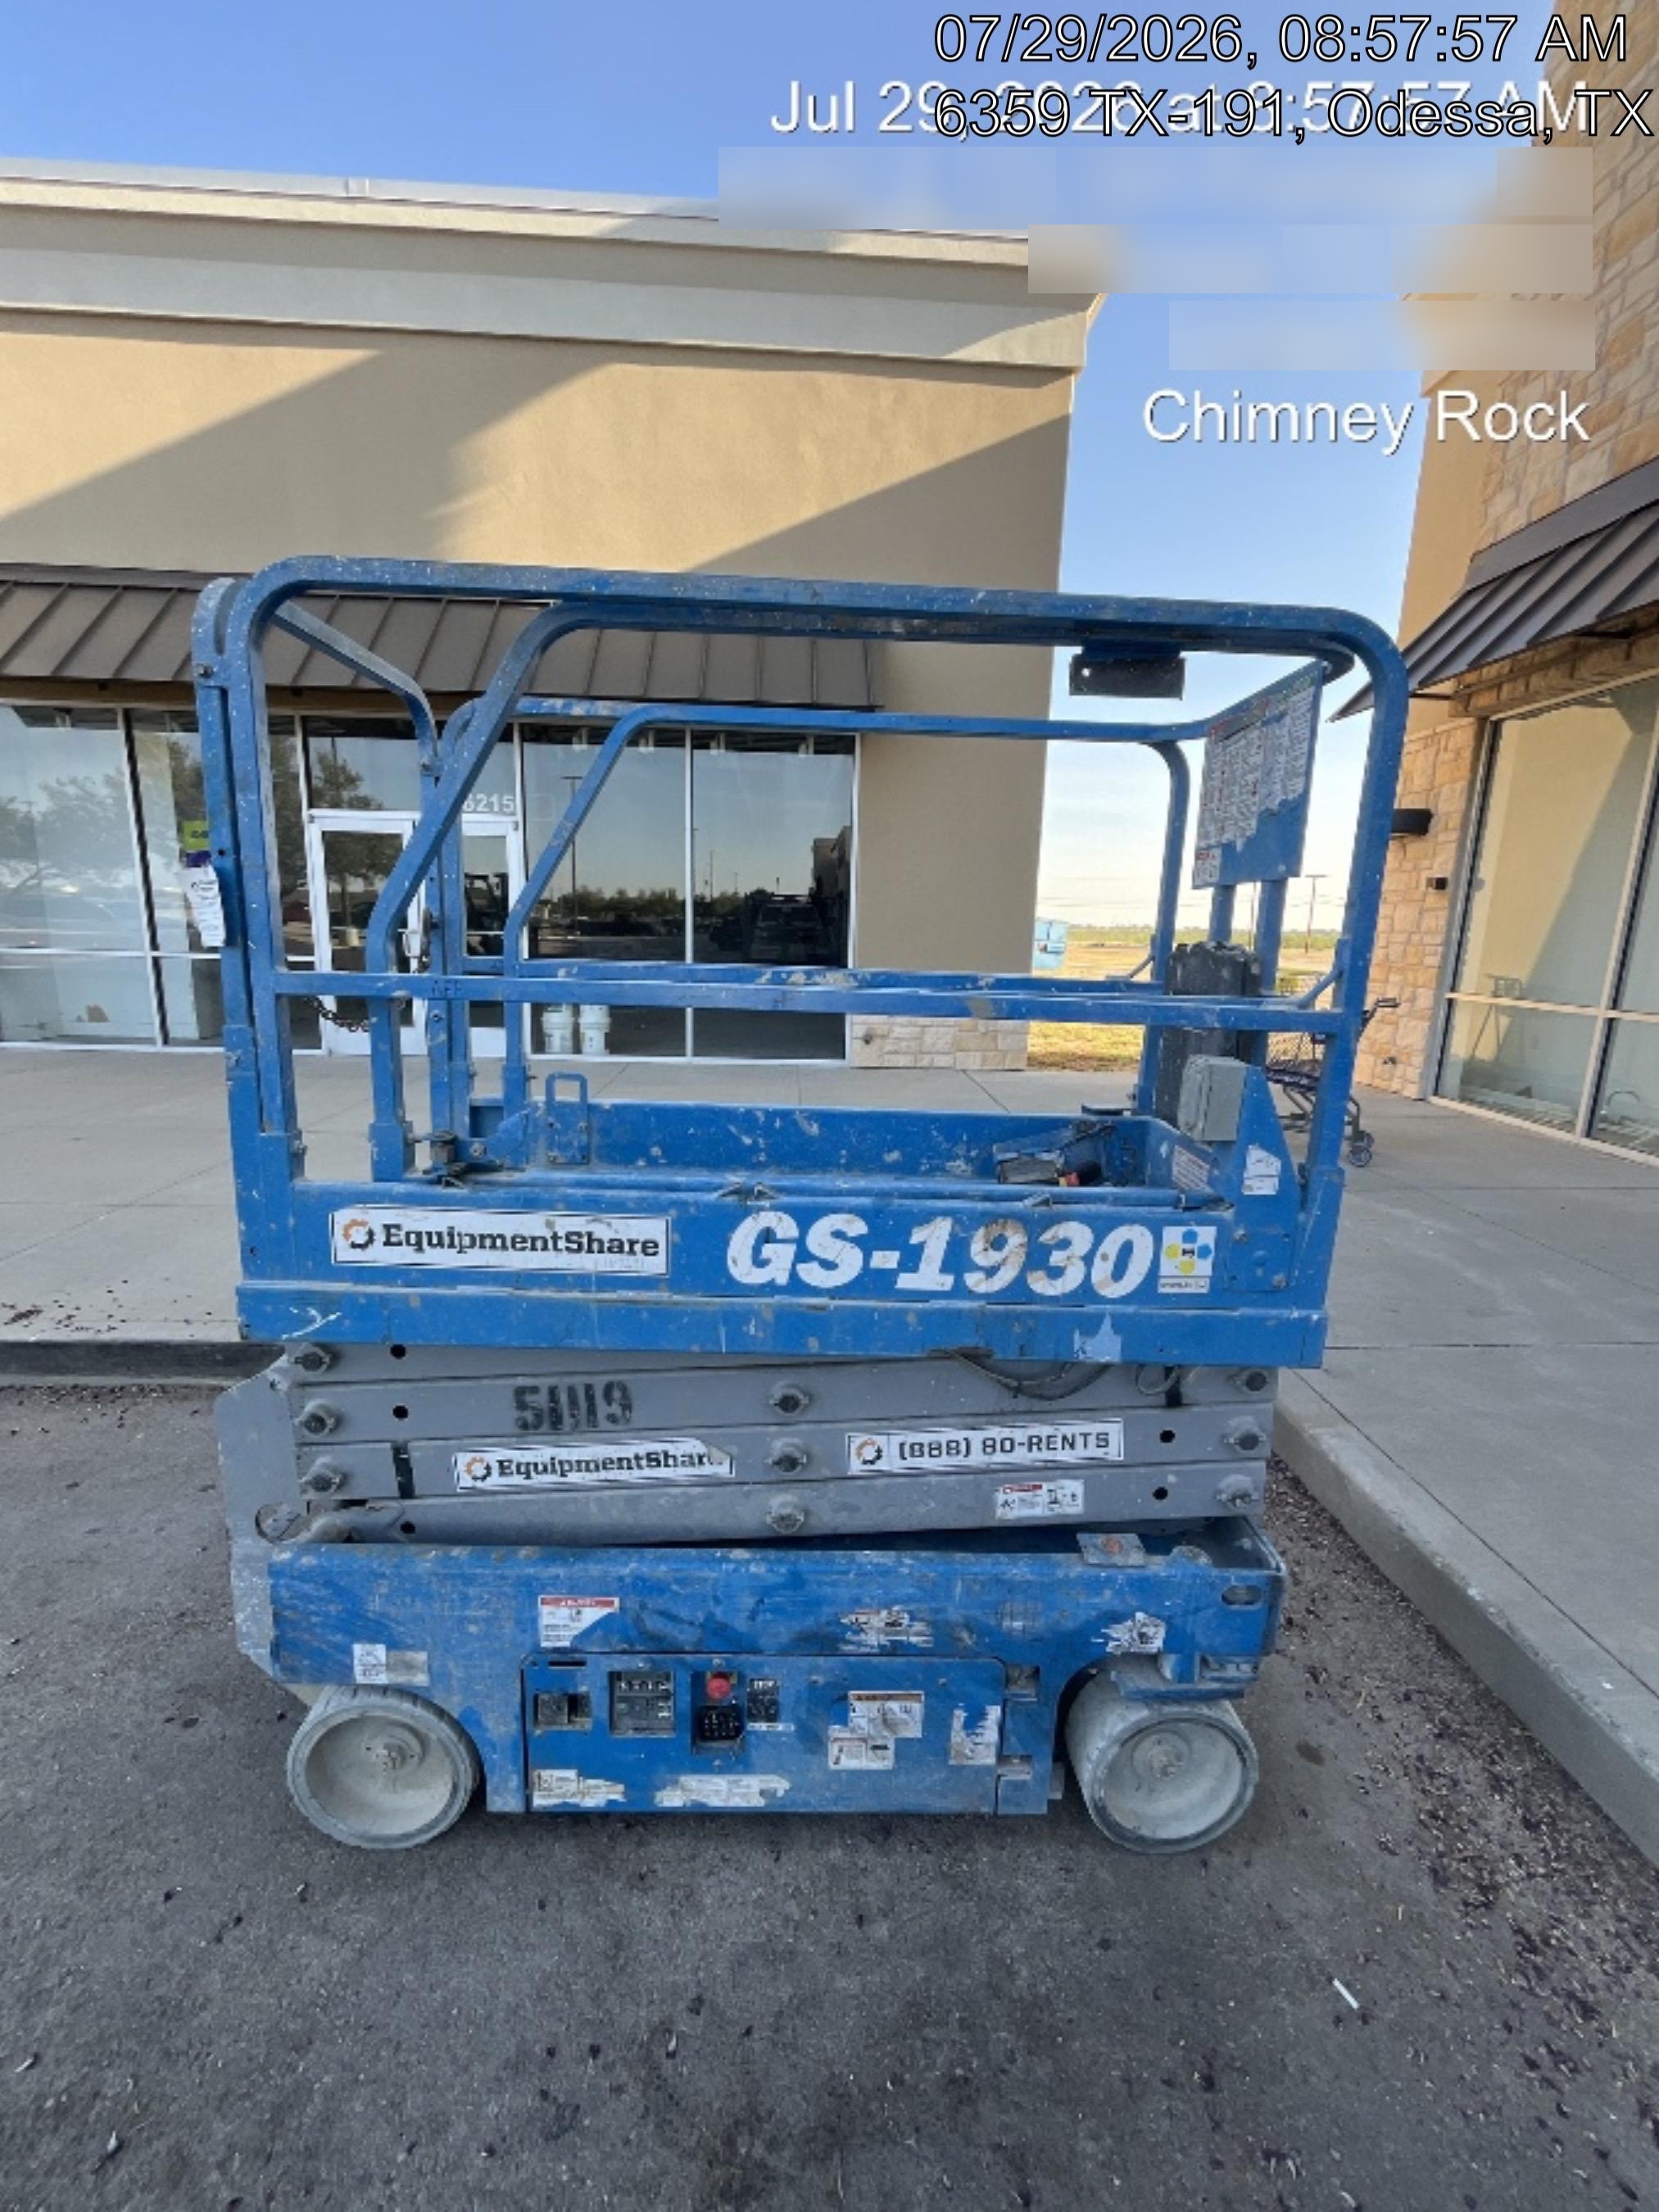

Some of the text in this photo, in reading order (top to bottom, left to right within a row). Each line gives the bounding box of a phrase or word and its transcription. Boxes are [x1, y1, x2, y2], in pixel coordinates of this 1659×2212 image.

[382, 1223, 660, 1257] EquipmentShare
[727, 1210, 1154, 1299] GS-1930
[899, 1431, 1110, 1461] (888) 80-RENTS
[496, 1449, 723, 1480] EquipmentShar
